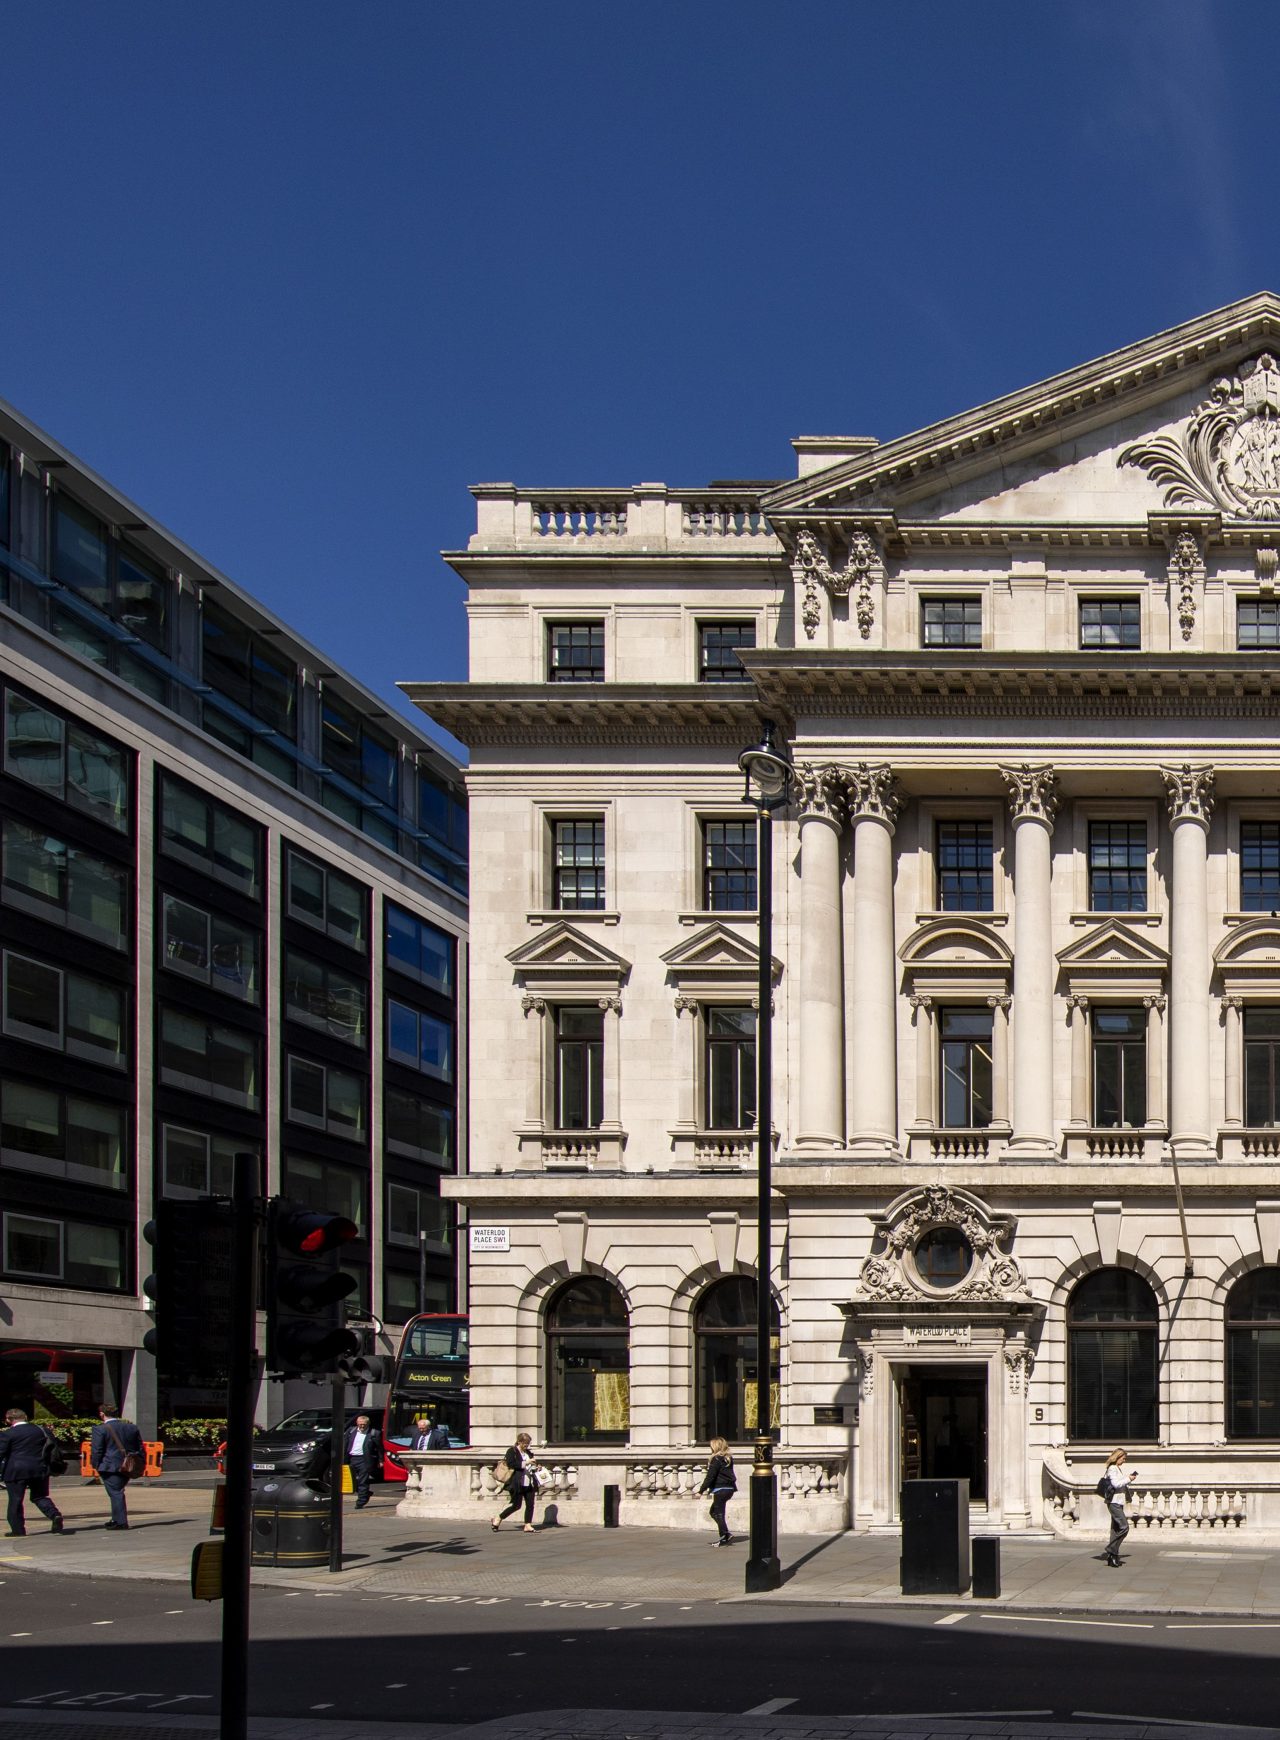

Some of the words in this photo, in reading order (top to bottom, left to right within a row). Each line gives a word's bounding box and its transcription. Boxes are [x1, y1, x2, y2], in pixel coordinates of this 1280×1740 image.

[908, 1324, 944, 1336] WATERLOO
[944, 1324, 968, 1336] PLACE
[408, 1373, 429, 1382] Acton
[430, 1373, 452, 1382] Green
[1035, 1408, 1044, 1421] 9
[361, 1594, 511, 1605] RIGHT
[524, 1599, 643, 1610] LOOK
[14, 1690, 214, 1708] LEFT
